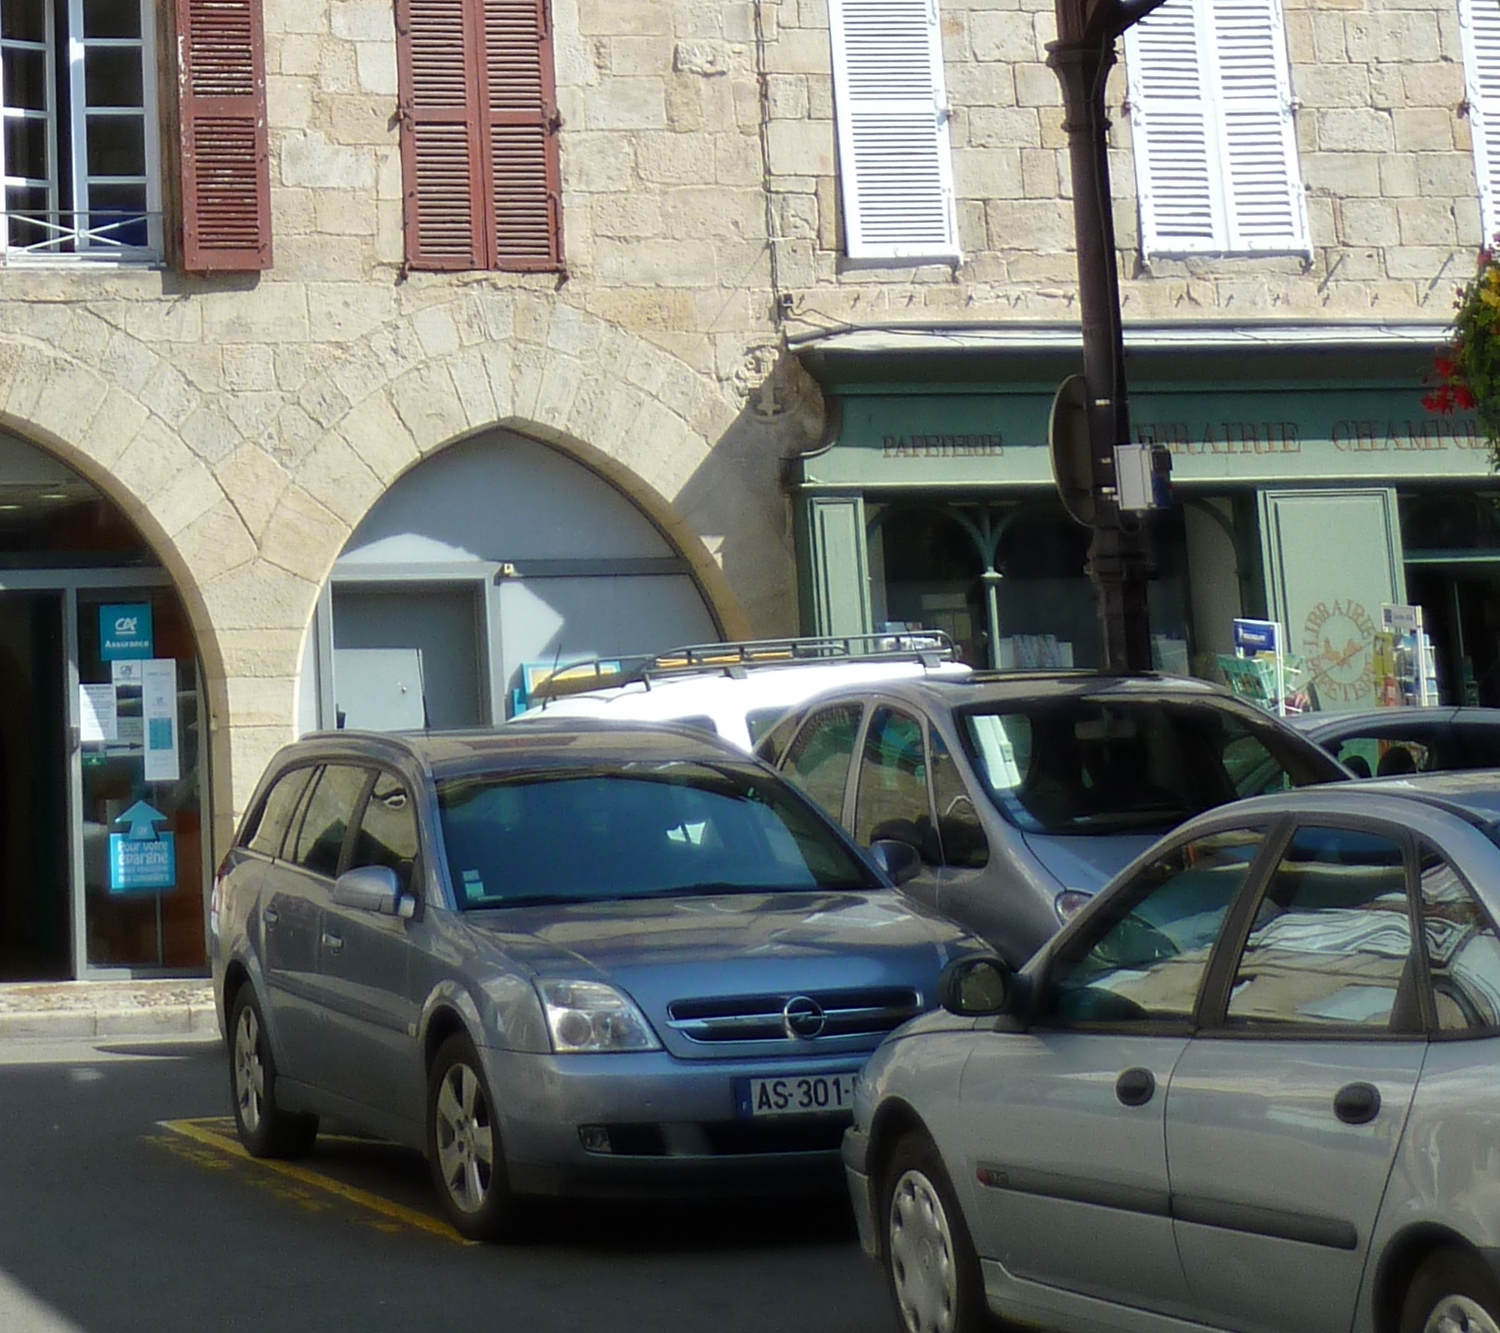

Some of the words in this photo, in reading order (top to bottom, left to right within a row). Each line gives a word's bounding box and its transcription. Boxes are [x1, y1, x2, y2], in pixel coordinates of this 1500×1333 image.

[882, 434, 1004, 458] PAPETERIE
[1133, 421, 1300, 454] IBRAIRIE
[1303, 598, 1377, 648] LIBRAIRIE
[105, 640, 149, 648] Assurance
[118, 841, 141, 852] Pour
[143, 841, 168, 851] votre
